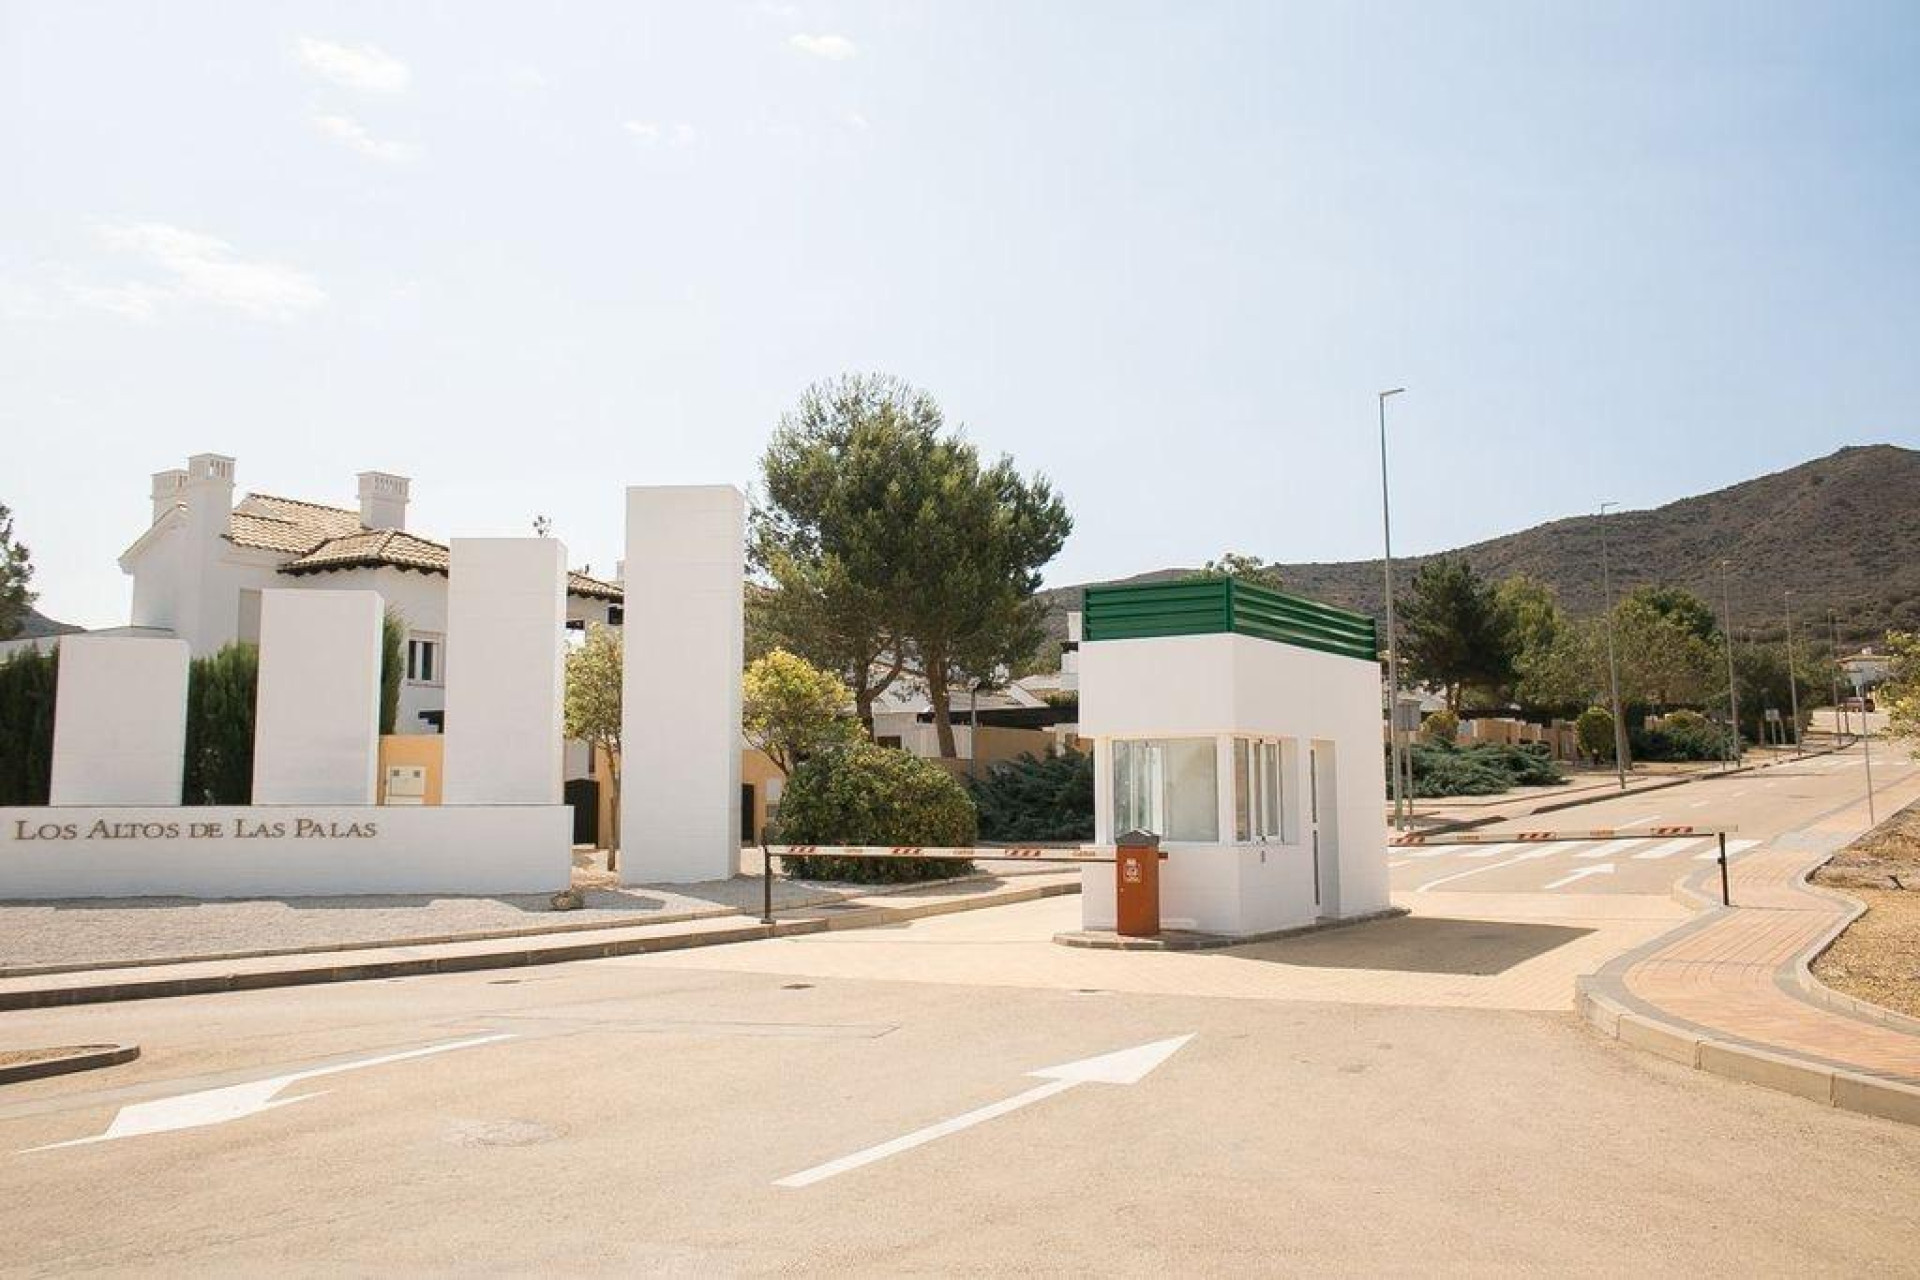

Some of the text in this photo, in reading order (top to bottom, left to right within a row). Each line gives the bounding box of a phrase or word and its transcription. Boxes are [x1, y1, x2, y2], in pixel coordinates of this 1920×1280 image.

[14, 818, 377, 840] LOS ALTOS DE LAS PALAS
